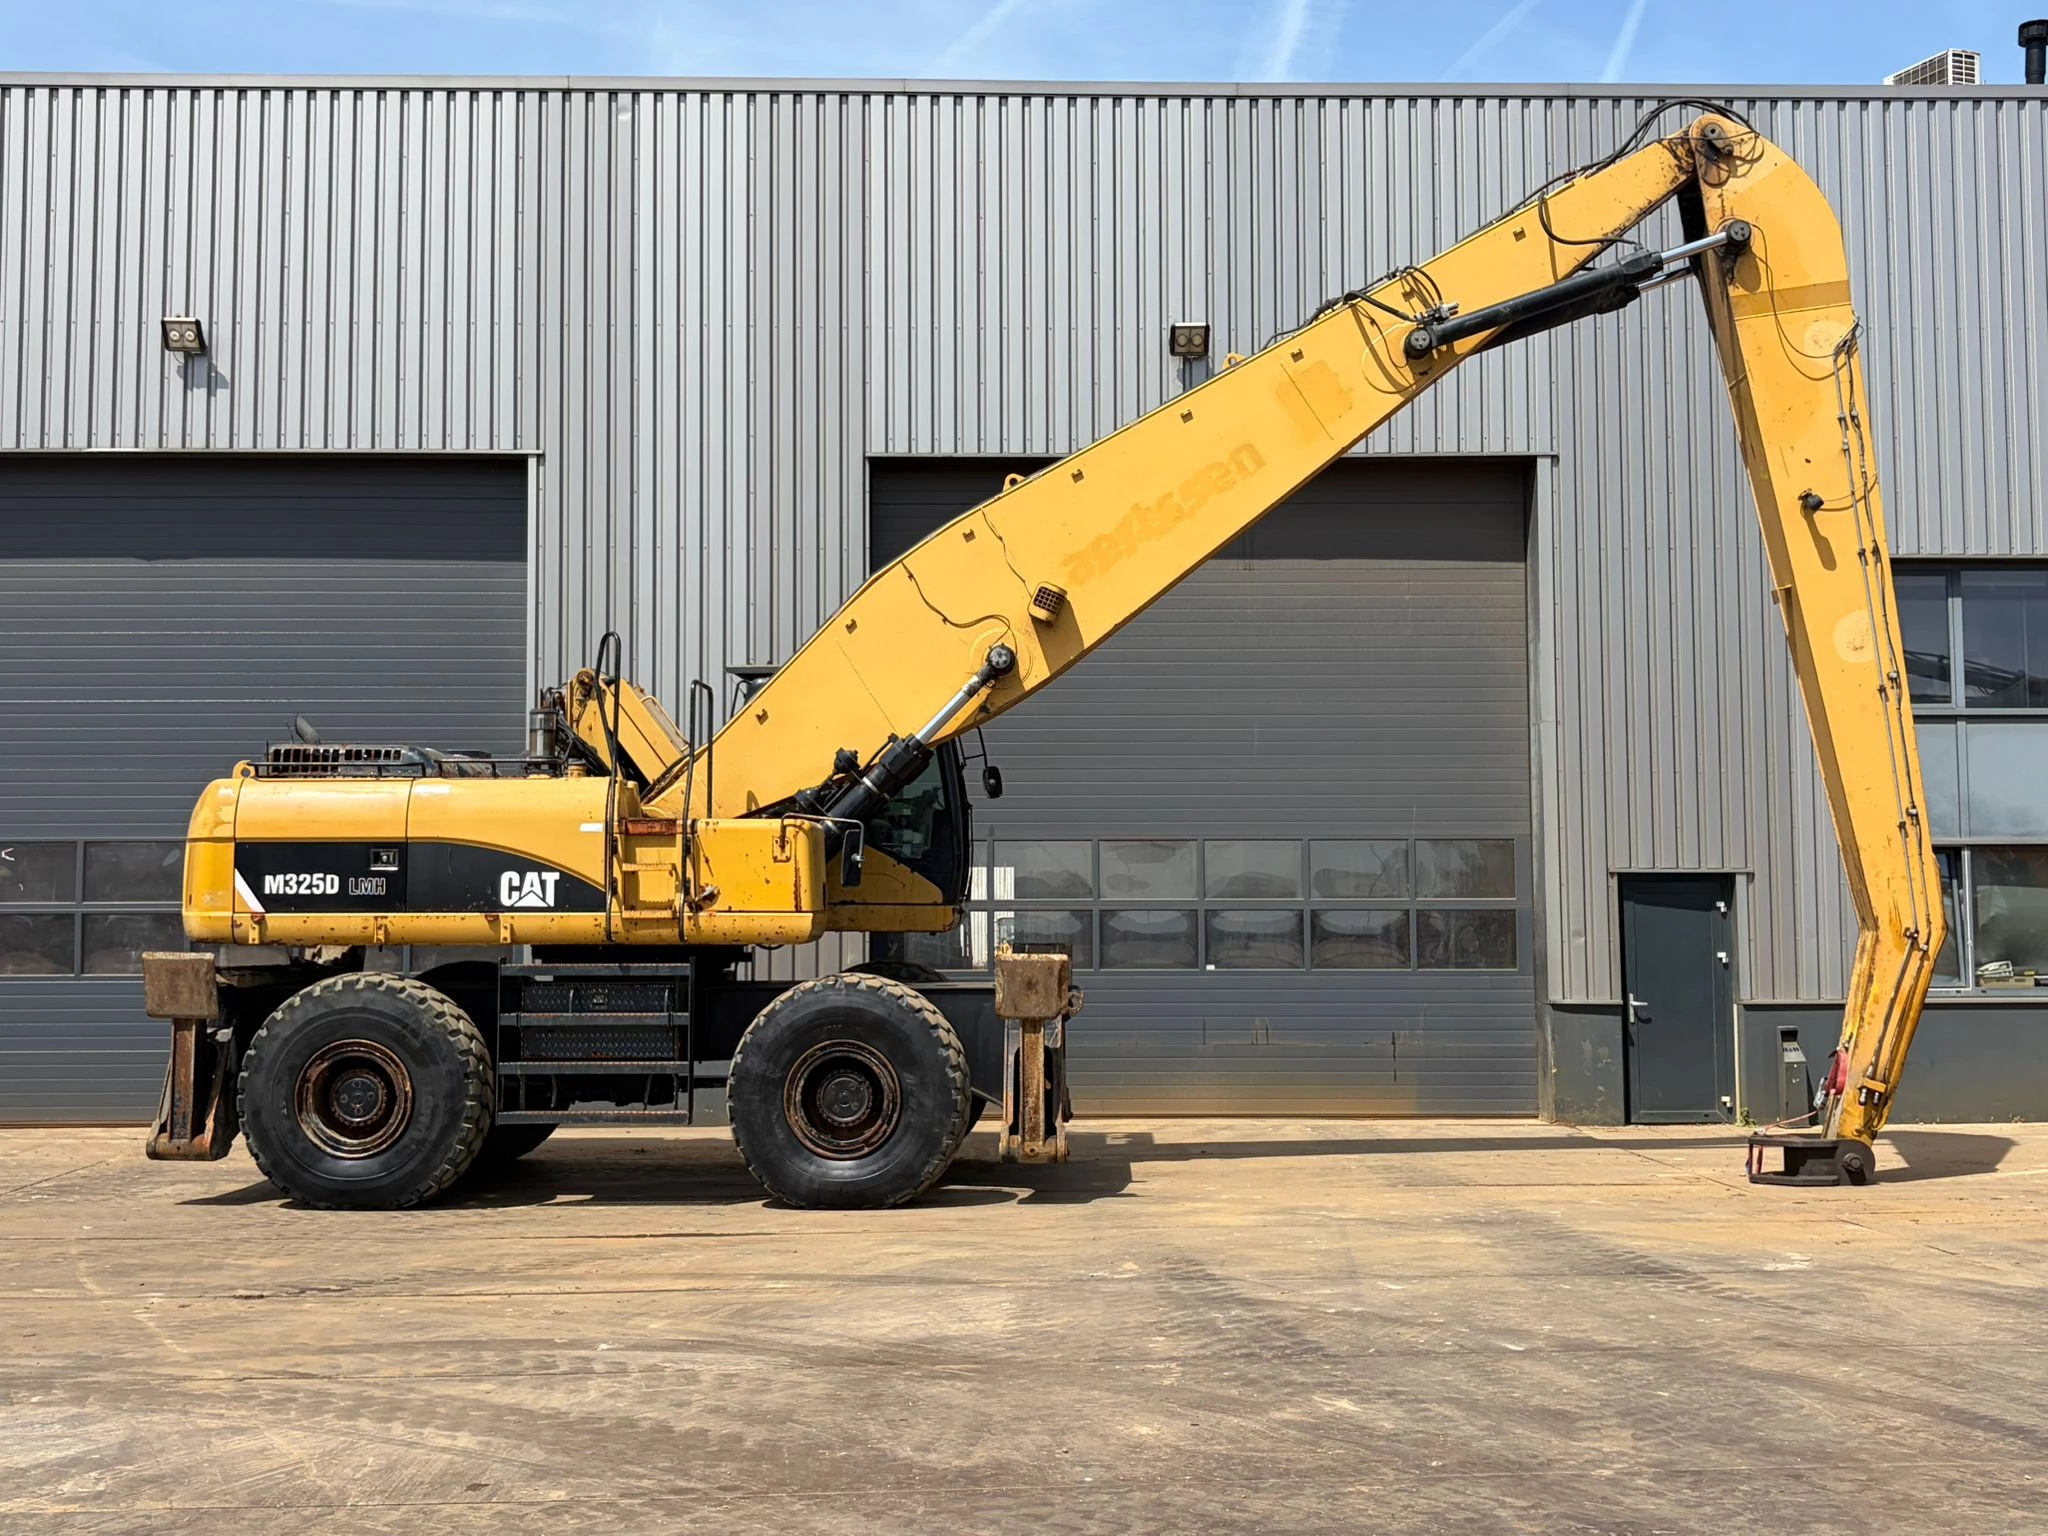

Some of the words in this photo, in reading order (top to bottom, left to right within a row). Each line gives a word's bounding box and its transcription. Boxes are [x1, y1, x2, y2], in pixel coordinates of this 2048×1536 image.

[264, 873, 340, 895] M325D
[349, 877, 386, 896] LMH
[500, 871, 560, 907] CAT
